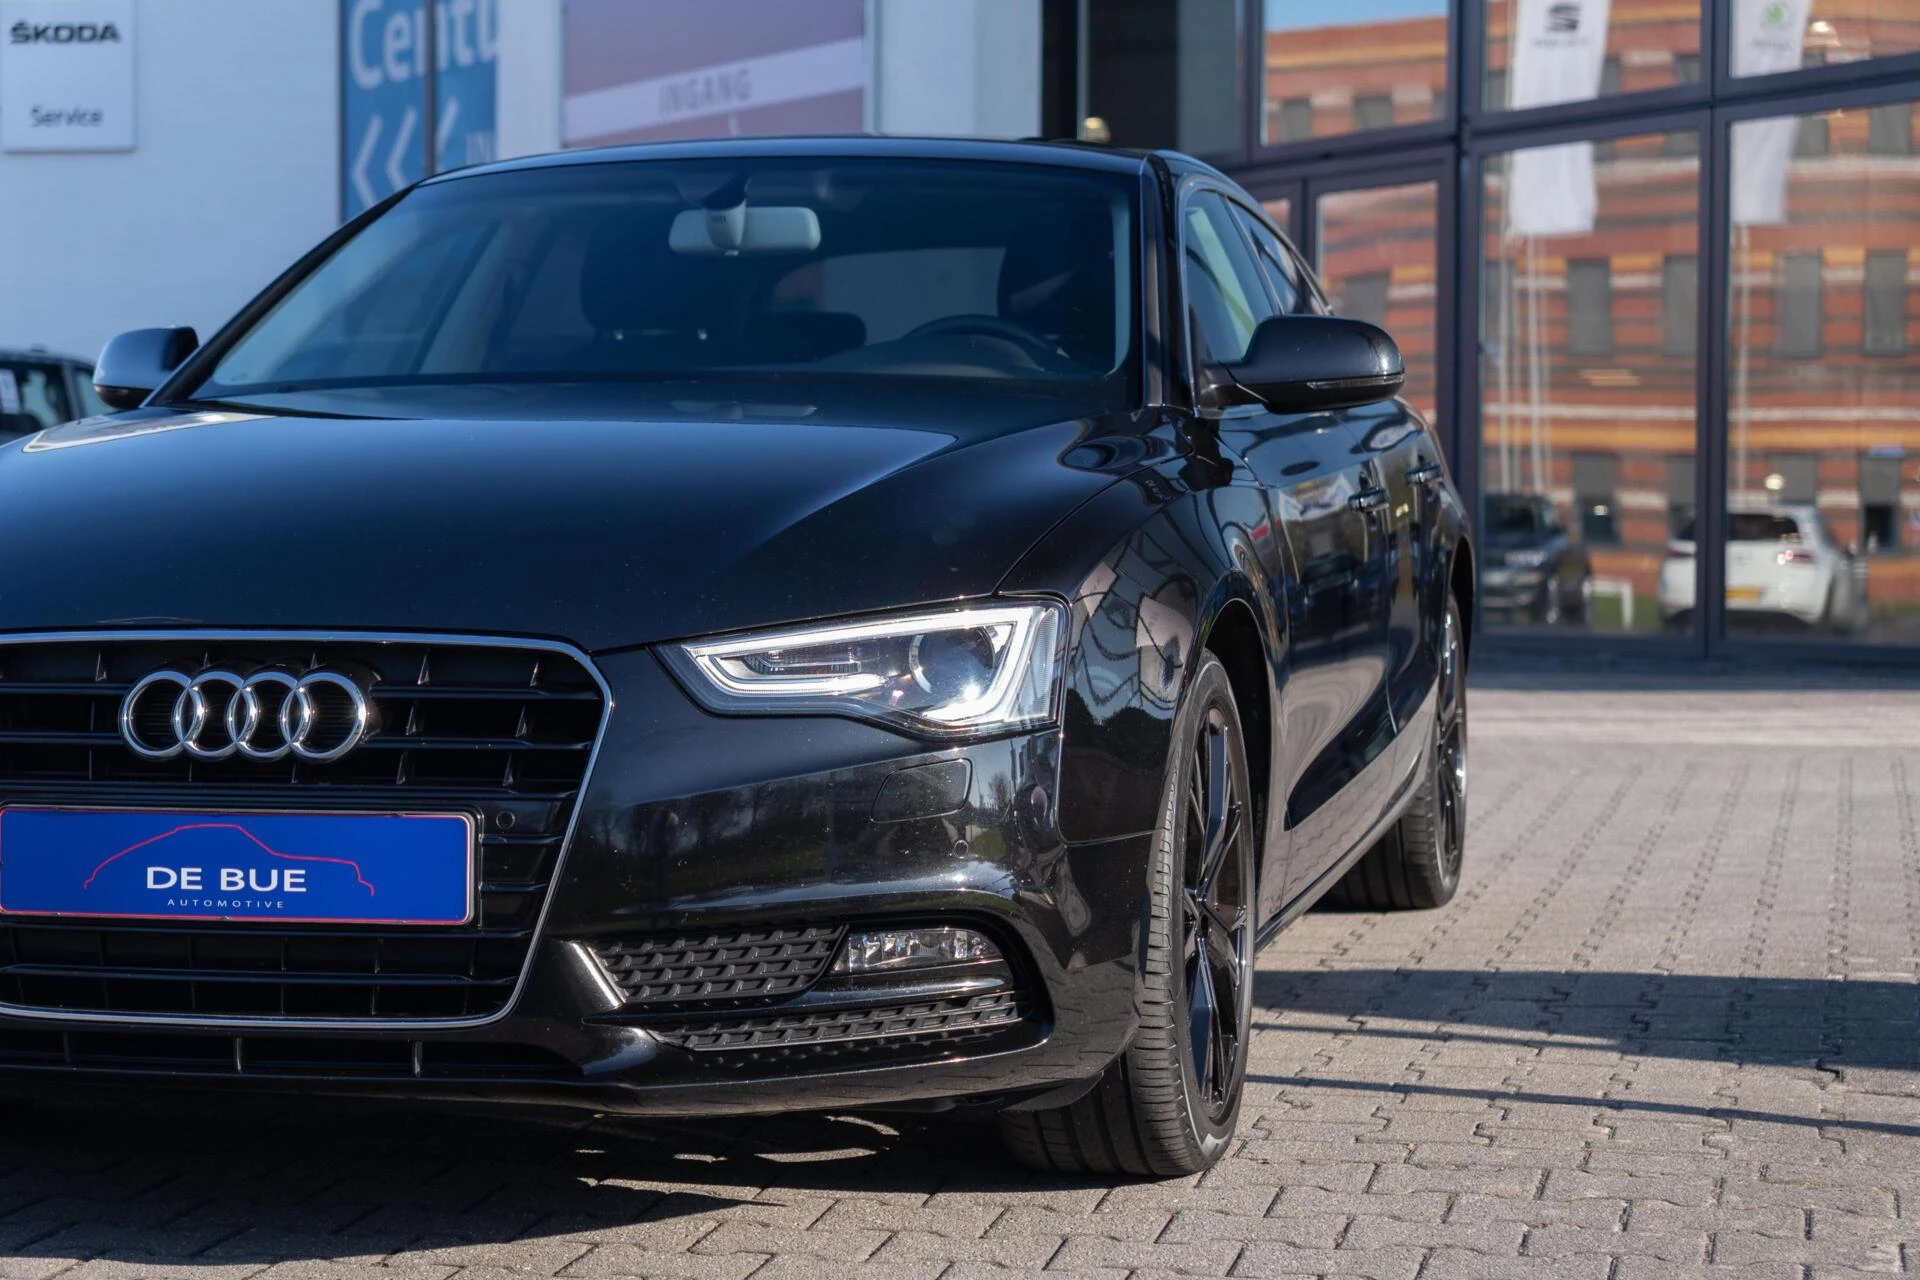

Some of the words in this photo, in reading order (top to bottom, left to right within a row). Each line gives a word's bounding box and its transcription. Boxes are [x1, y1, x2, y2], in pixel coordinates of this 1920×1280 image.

[10, 20, 121, 43] ŠKODA
[658, 68, 752, 116] INGANG
[30, 104, 103, 128] Service
[146, 866, 203, 890] DE
[220, 867, 307, 892] BUE
[167, 899, 284, 909] AUTOMOTIVE
